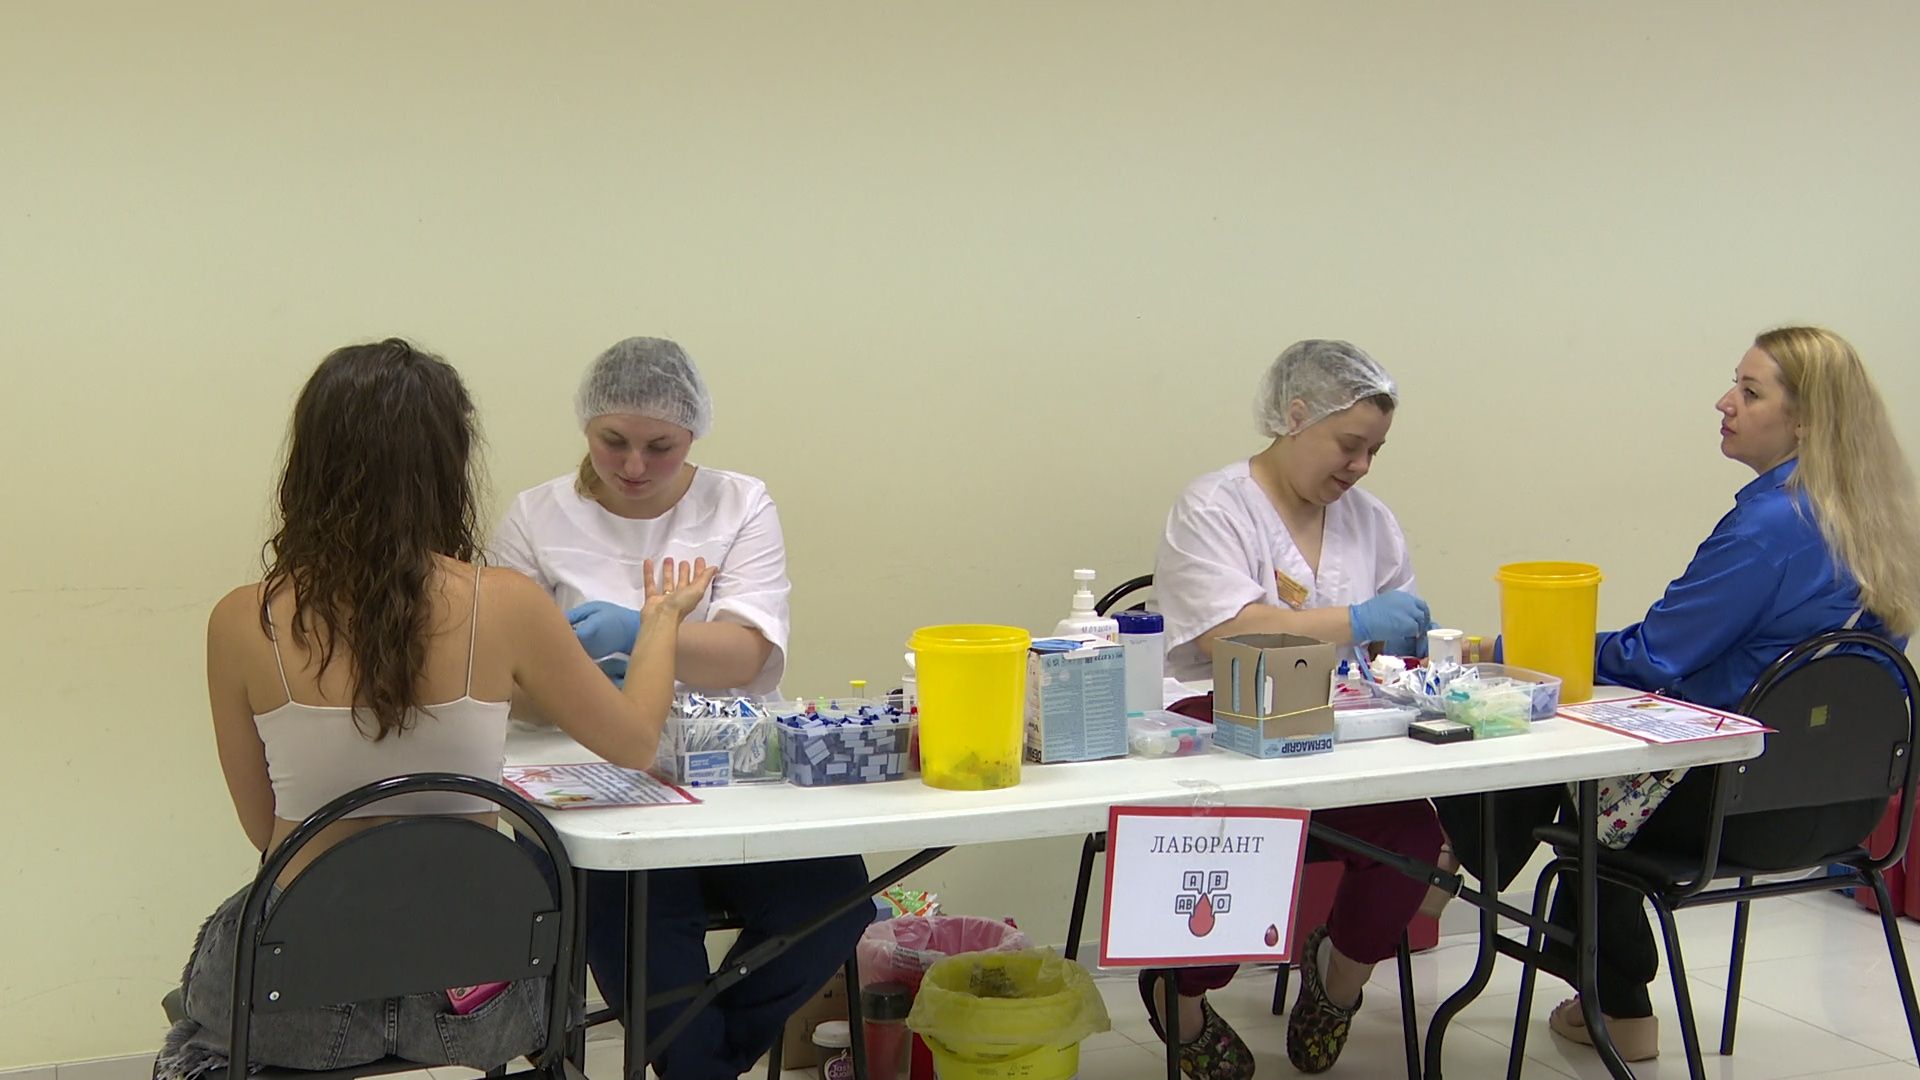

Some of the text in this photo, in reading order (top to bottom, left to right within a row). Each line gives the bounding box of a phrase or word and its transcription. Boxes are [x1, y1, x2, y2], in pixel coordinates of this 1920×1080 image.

[1281, 739, 1332, 754] DERMAGRIP
[1150, 836, 1264, 854] ЛАБОРАНТ
[1189, 875, 1197, 887] A
[1214, 875, 1222, 887] B
[1178, 899, 1193, 911] AB
